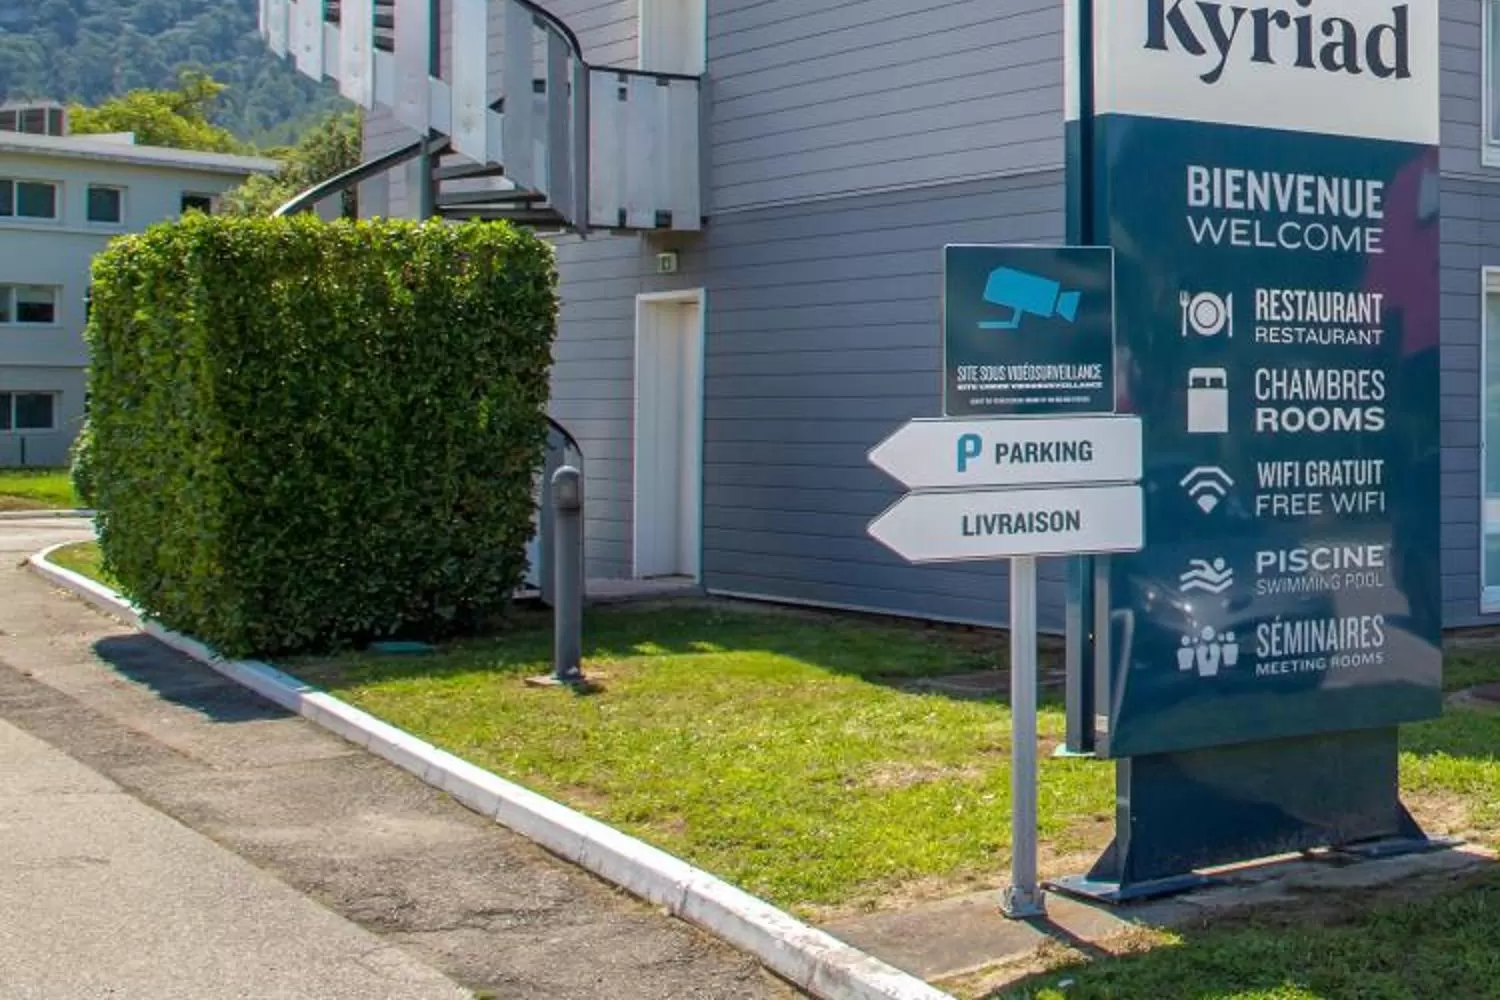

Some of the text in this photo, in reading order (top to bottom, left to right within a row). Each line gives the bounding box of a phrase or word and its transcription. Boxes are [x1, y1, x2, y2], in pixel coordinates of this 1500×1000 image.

[1186, 164, 1385, 220] BIENVENUE
[1186, 215, 1385, 254] WELCOME
[1255, 288, 1384, 325] RESTAURANT
[1255, 326, 1384, 345] RESTAURANT
[956, 365, 978, 382] SITE
[979, 364, 1006, 381] SOUS
[1255, 368, 1385, 402] CHAMBRES
[1256, 407, 1385, 433] ROOMS
[994, 440, 1093, 465] PARKING
[1257, 459, 1384, 488] WIFI GRATUIT
[1255, 491, 1385, 517] FREE WIFI
[962, 510, 1081, 537] LIVRAISON
[1256, 545, 1384, 574] PISCINE
[1256, 571, 1384, 596] SWIMMING POOL
[1256, 614, 1385, 659] SÉMINAIRES
[1255, 651, 1384, 677] MEETING ROOMS
